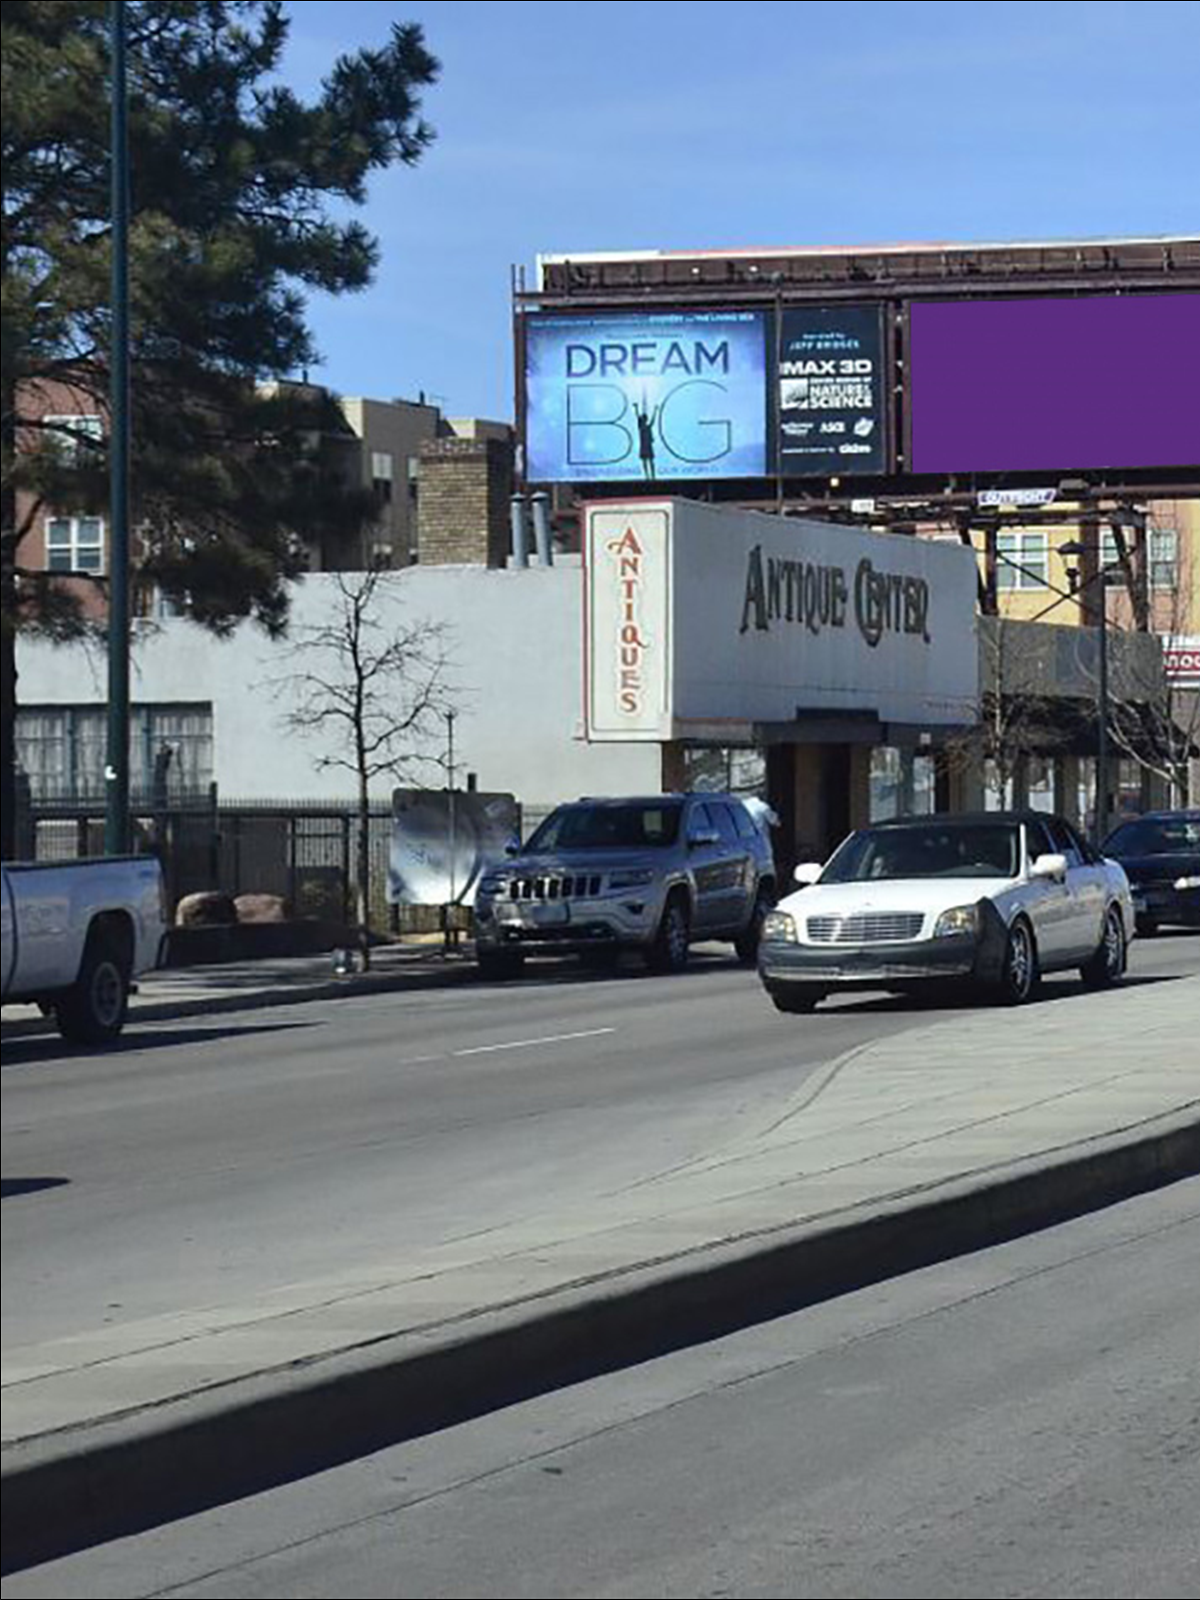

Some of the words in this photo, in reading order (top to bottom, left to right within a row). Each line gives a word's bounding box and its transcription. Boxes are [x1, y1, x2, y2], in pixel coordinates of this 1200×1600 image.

[566, 341, 729, 377] DREAM
[839, 360, 873, 375] 3D
[810, 396, 873, 409] SCIENCE
[740, 543, 848, 636] ANTIQUE
[855, 556, 932, 648] CENTER
[607, 527, 648, 713] ANTIQUES
